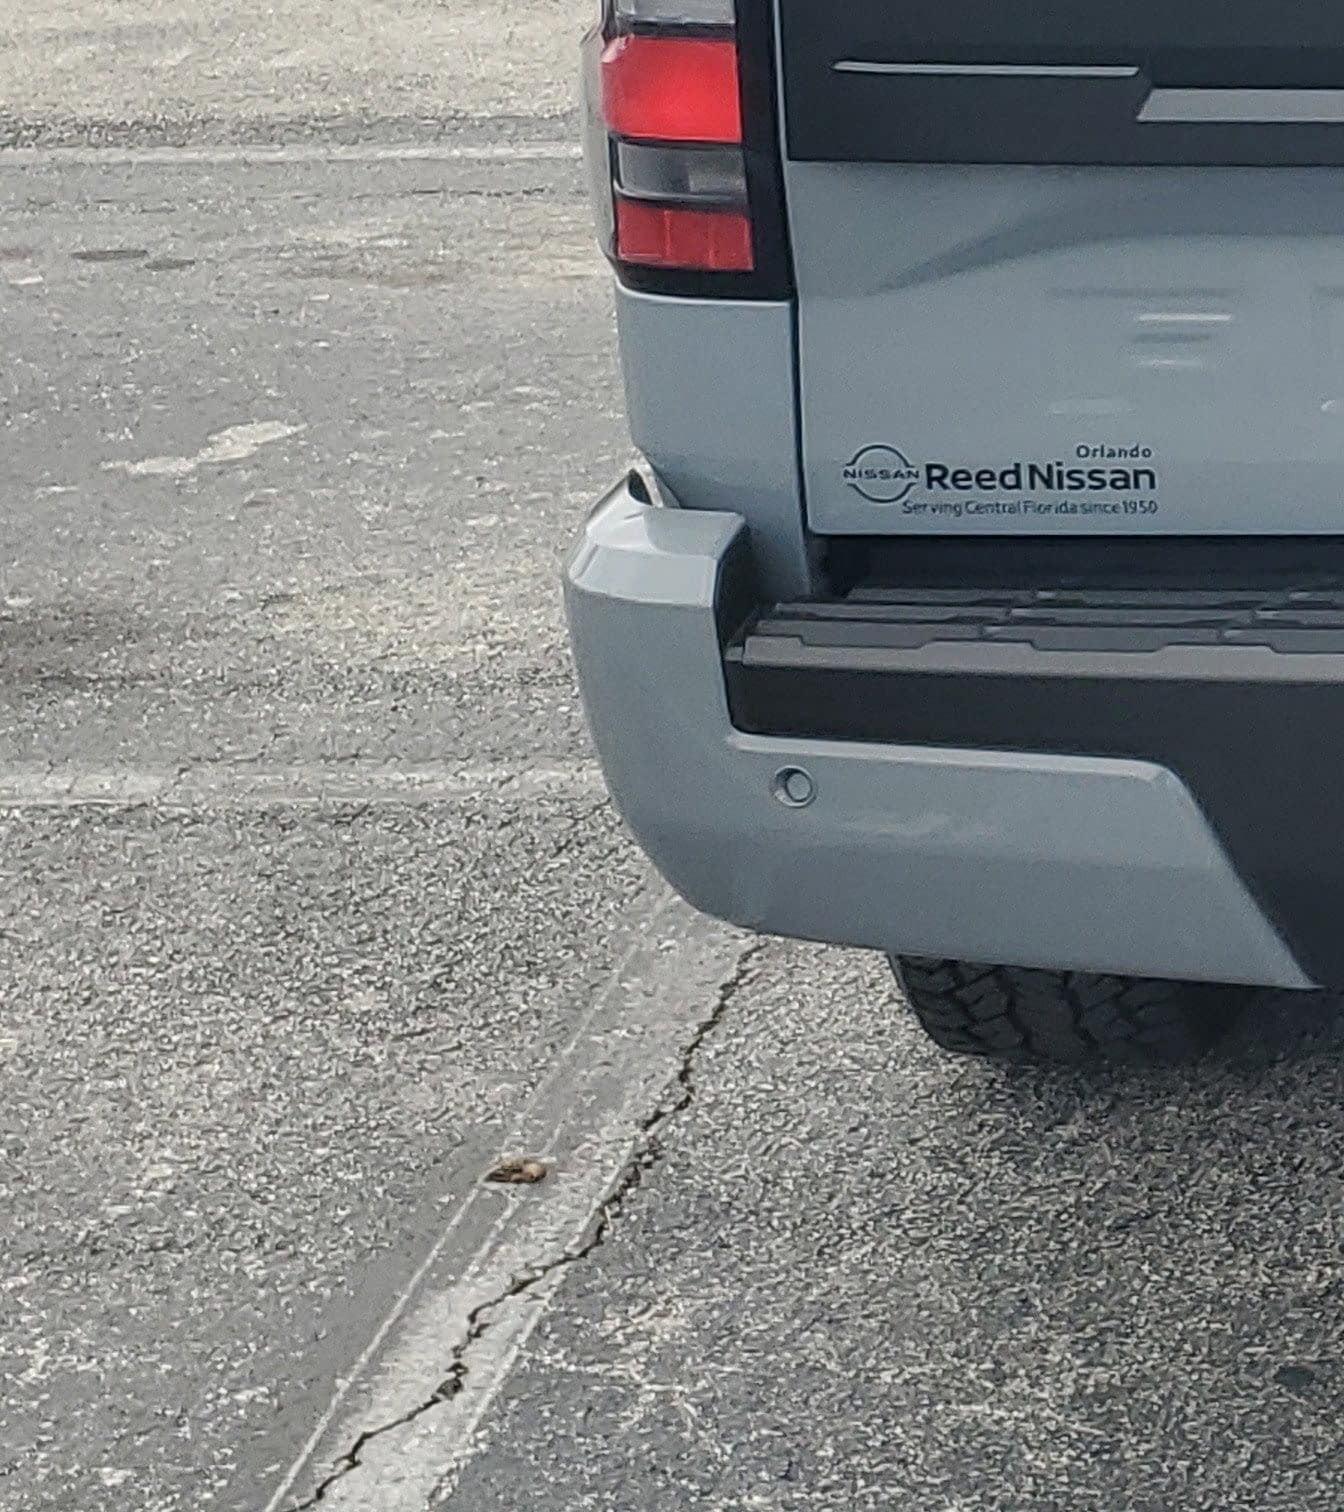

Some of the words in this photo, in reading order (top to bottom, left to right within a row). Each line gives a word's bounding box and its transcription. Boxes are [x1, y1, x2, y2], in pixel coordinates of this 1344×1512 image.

[1075, 444, 1153, 459] Orlando
[843, 467, 919, 481] NISSAN
[924, 461, 1022, 490] Reed
[1027, 461, 1157, 490] Nissan
[901, 499, 962, 517] Serving
[964, 499, 1021, 515] Central
[1022, 499, 1078, 515] Florida
[1079, 500, 1121, 515] since
[1122, 500, 1158, 515] 1950
